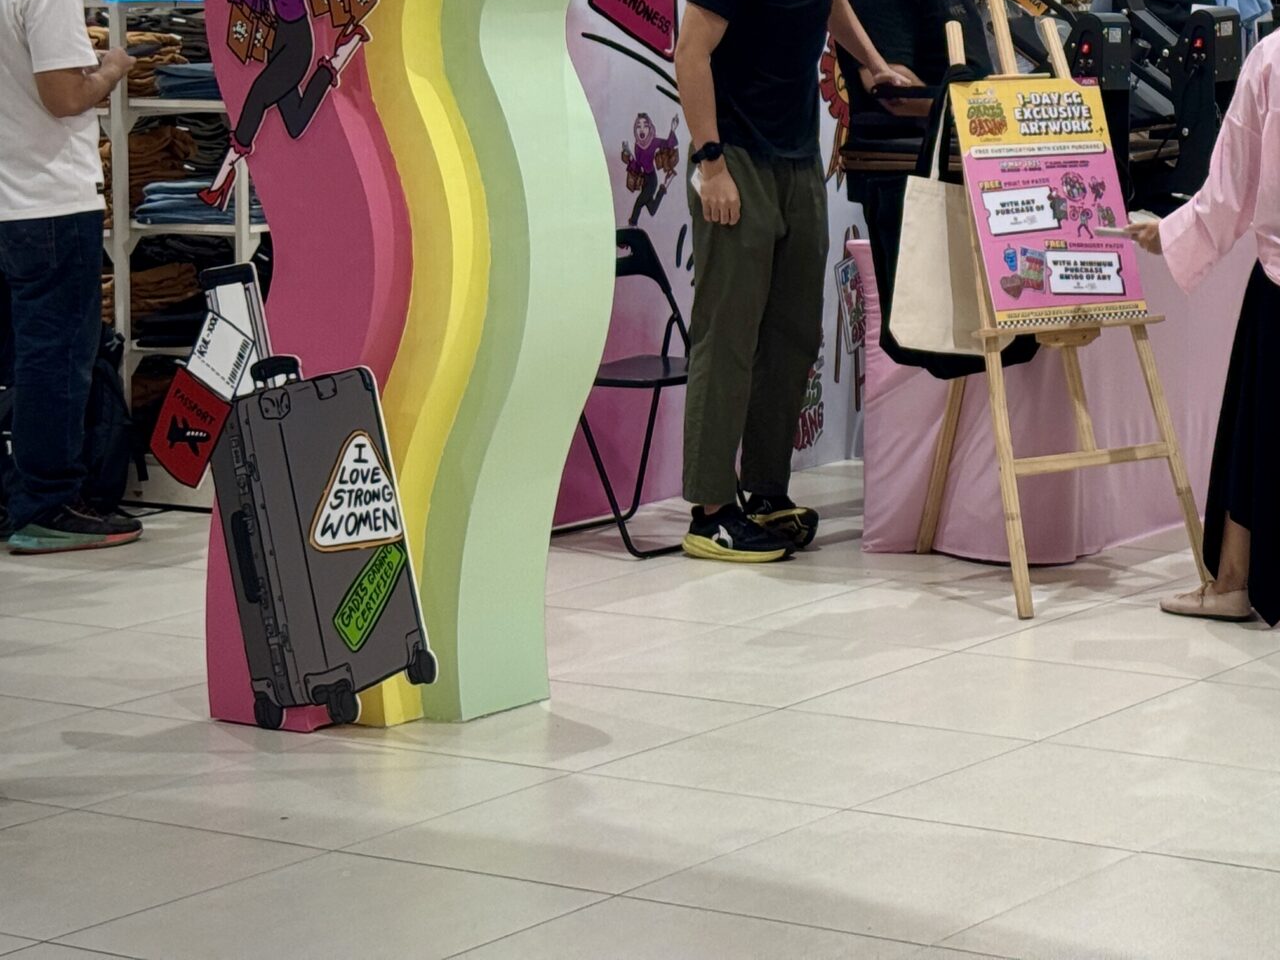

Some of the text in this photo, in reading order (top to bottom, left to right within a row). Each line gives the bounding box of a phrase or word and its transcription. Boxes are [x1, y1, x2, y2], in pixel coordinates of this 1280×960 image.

[1016, 91, 1083, 106] 1-DAY GG
[1014, 106, 1092, 121] EXCLUSIVE
[1019, 120, 1093, 136] ARTWORK
[995, 206, 1034, 216] PURCHASE
[1000, 200, 1019, 208] WITH
[176, 388, 216, 425] PASSPORT
[353, 443, 368, 463] I
[339, 466, 381, 485] LOVE
[329, 485, 393, 510] STRONG
[320, 506, 398, 540] WOMEN
[340, 544, 393, 629] GADIS GADANG
[355, 560, 394, 632] CERTIFIED
